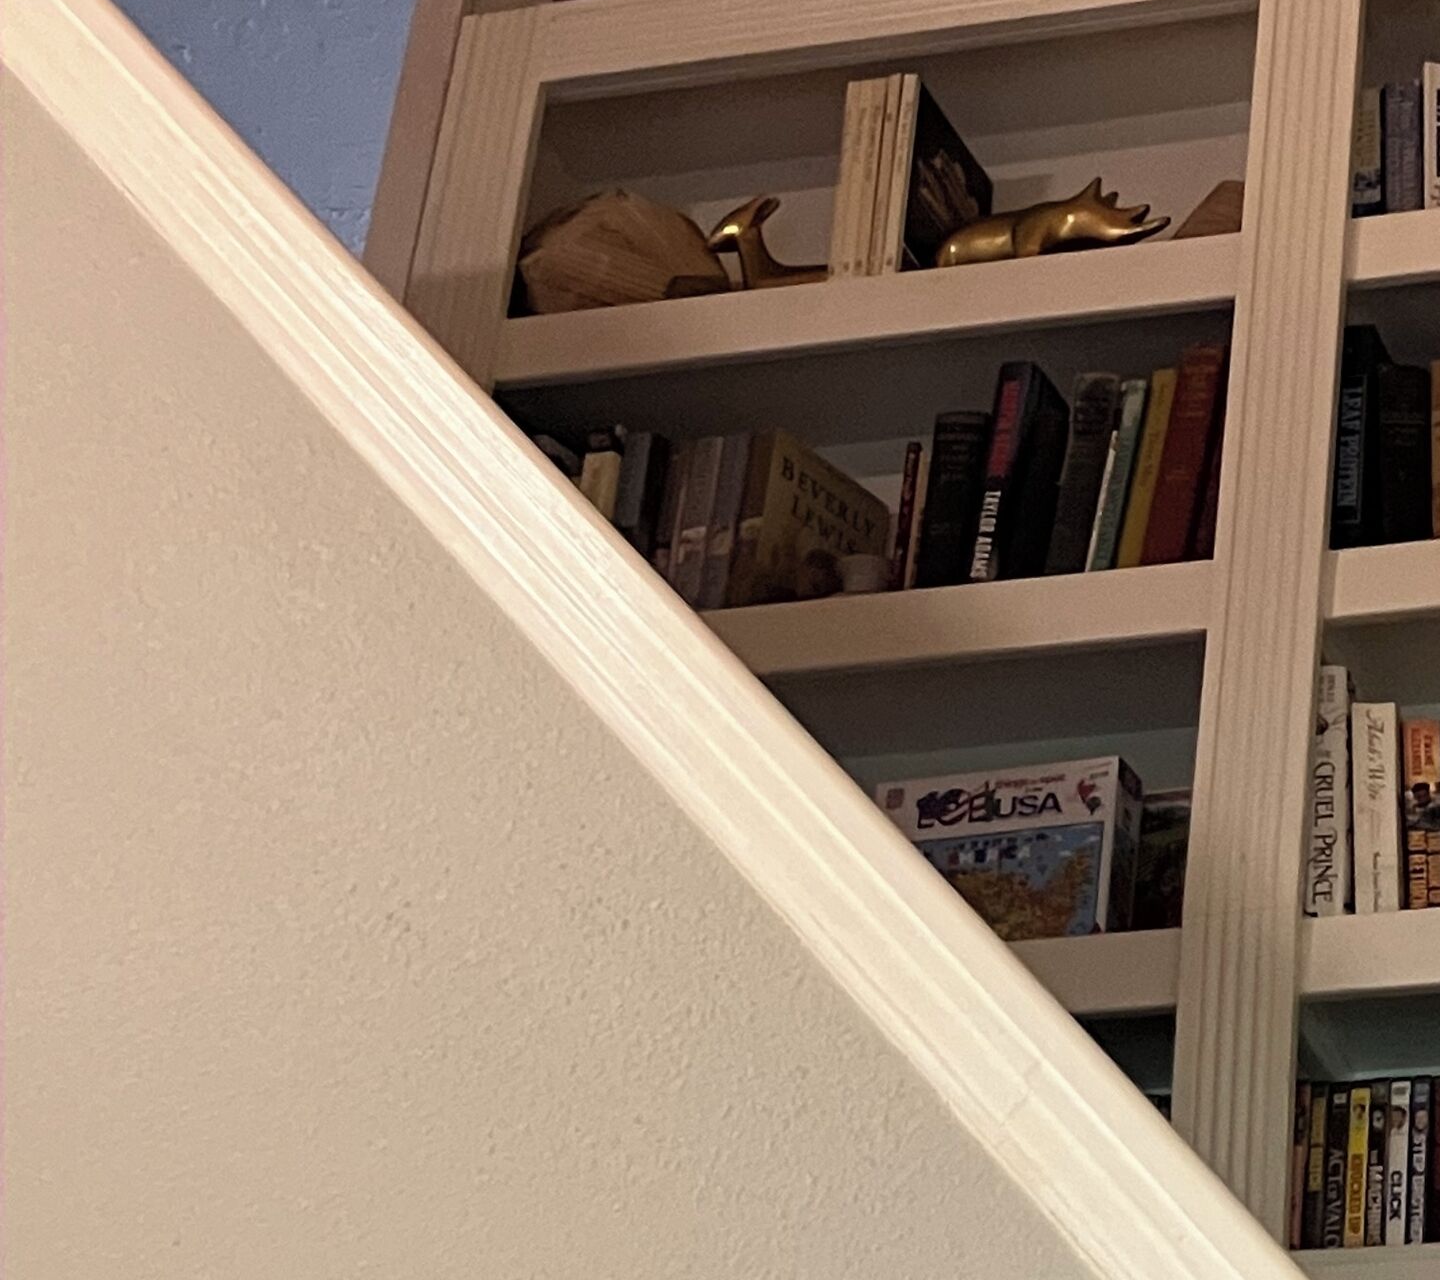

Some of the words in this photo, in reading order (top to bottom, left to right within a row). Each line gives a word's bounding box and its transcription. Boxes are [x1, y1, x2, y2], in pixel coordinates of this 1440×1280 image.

[1340, 386, 1362, 428] LEAF
[1336, 435, 1360, 507] PROTEIN
[977, 490, 1002, 533] TAYLOR
[969, 536, 995, 579] ADAMS
[996, 793, 1062, 818] USA
[1313, 762, 1336, 827] CRUEL
[1307, 829, 1339, 905] PRINCE
[1389, 1170, 1403, 1221] CLICK
